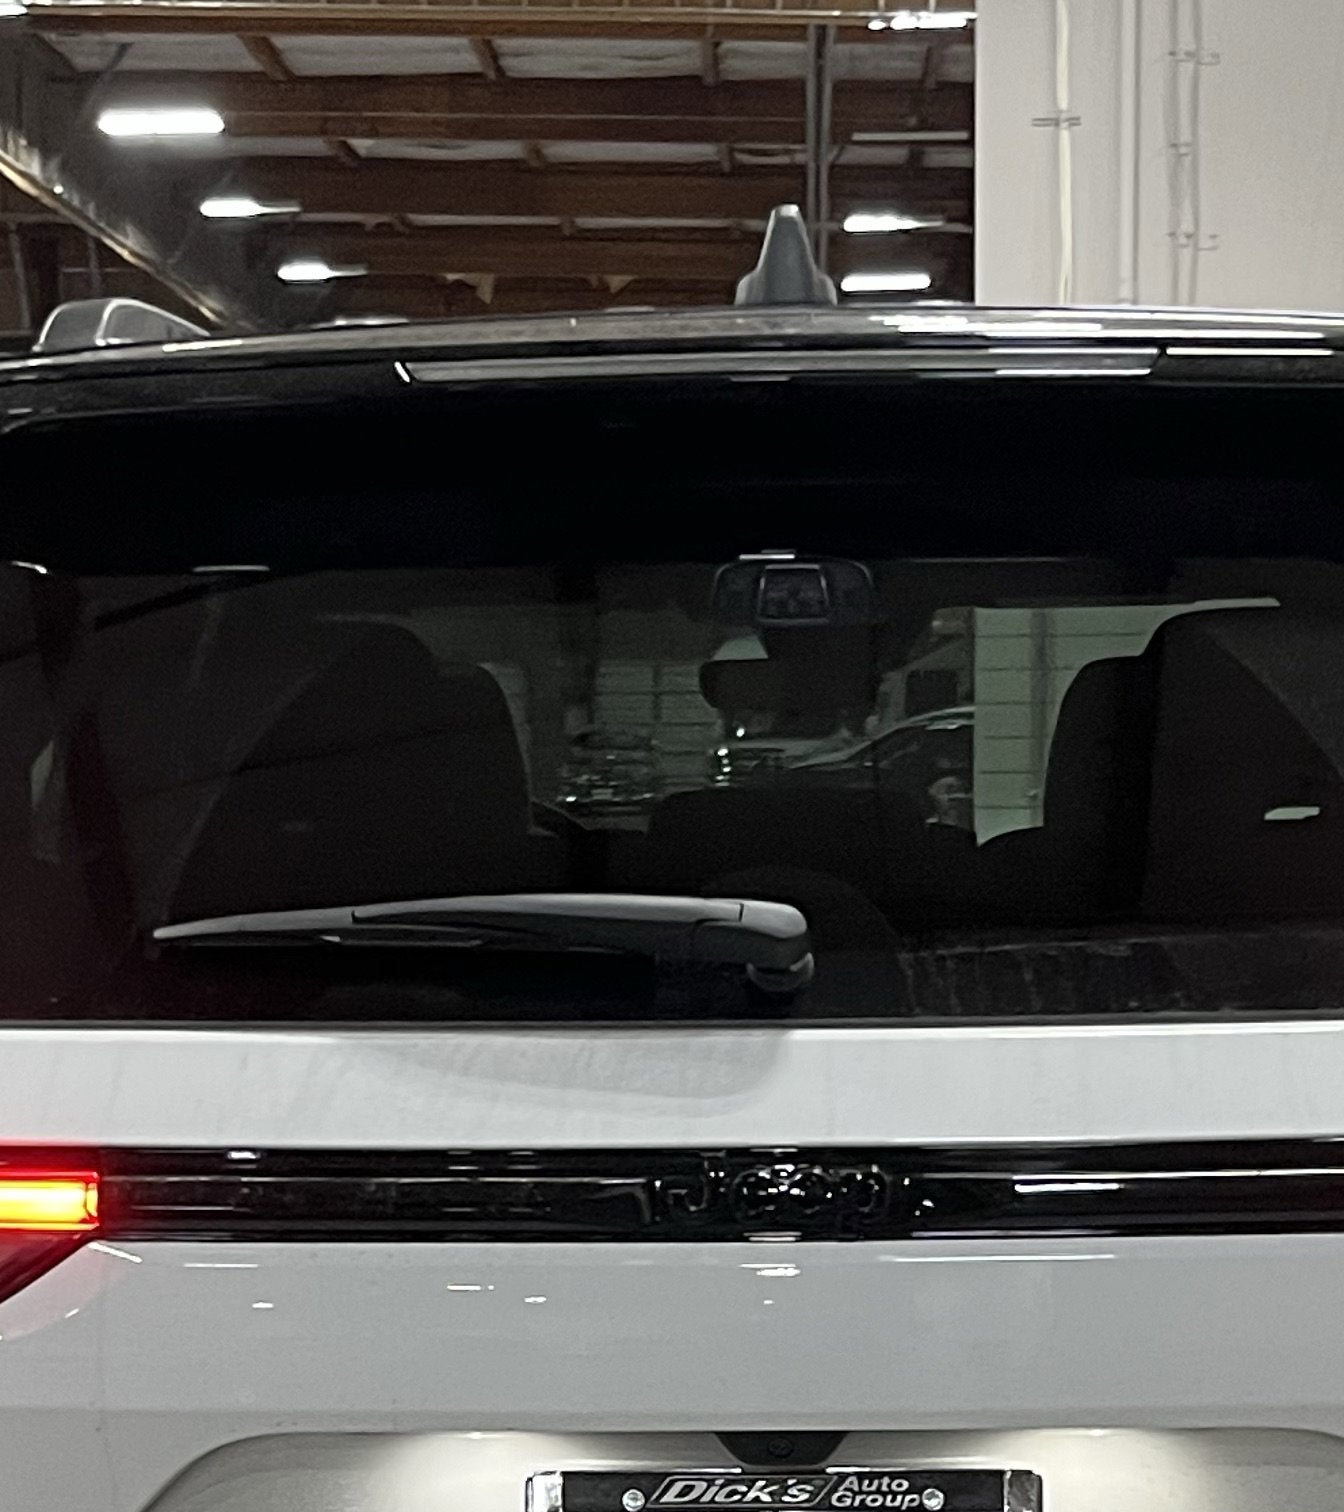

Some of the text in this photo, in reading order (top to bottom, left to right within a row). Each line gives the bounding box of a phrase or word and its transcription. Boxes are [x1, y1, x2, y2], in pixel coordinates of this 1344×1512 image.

[659, 1475, 910, 1504] Dick's Auto
[830, 1491, 922, 1511] Group
